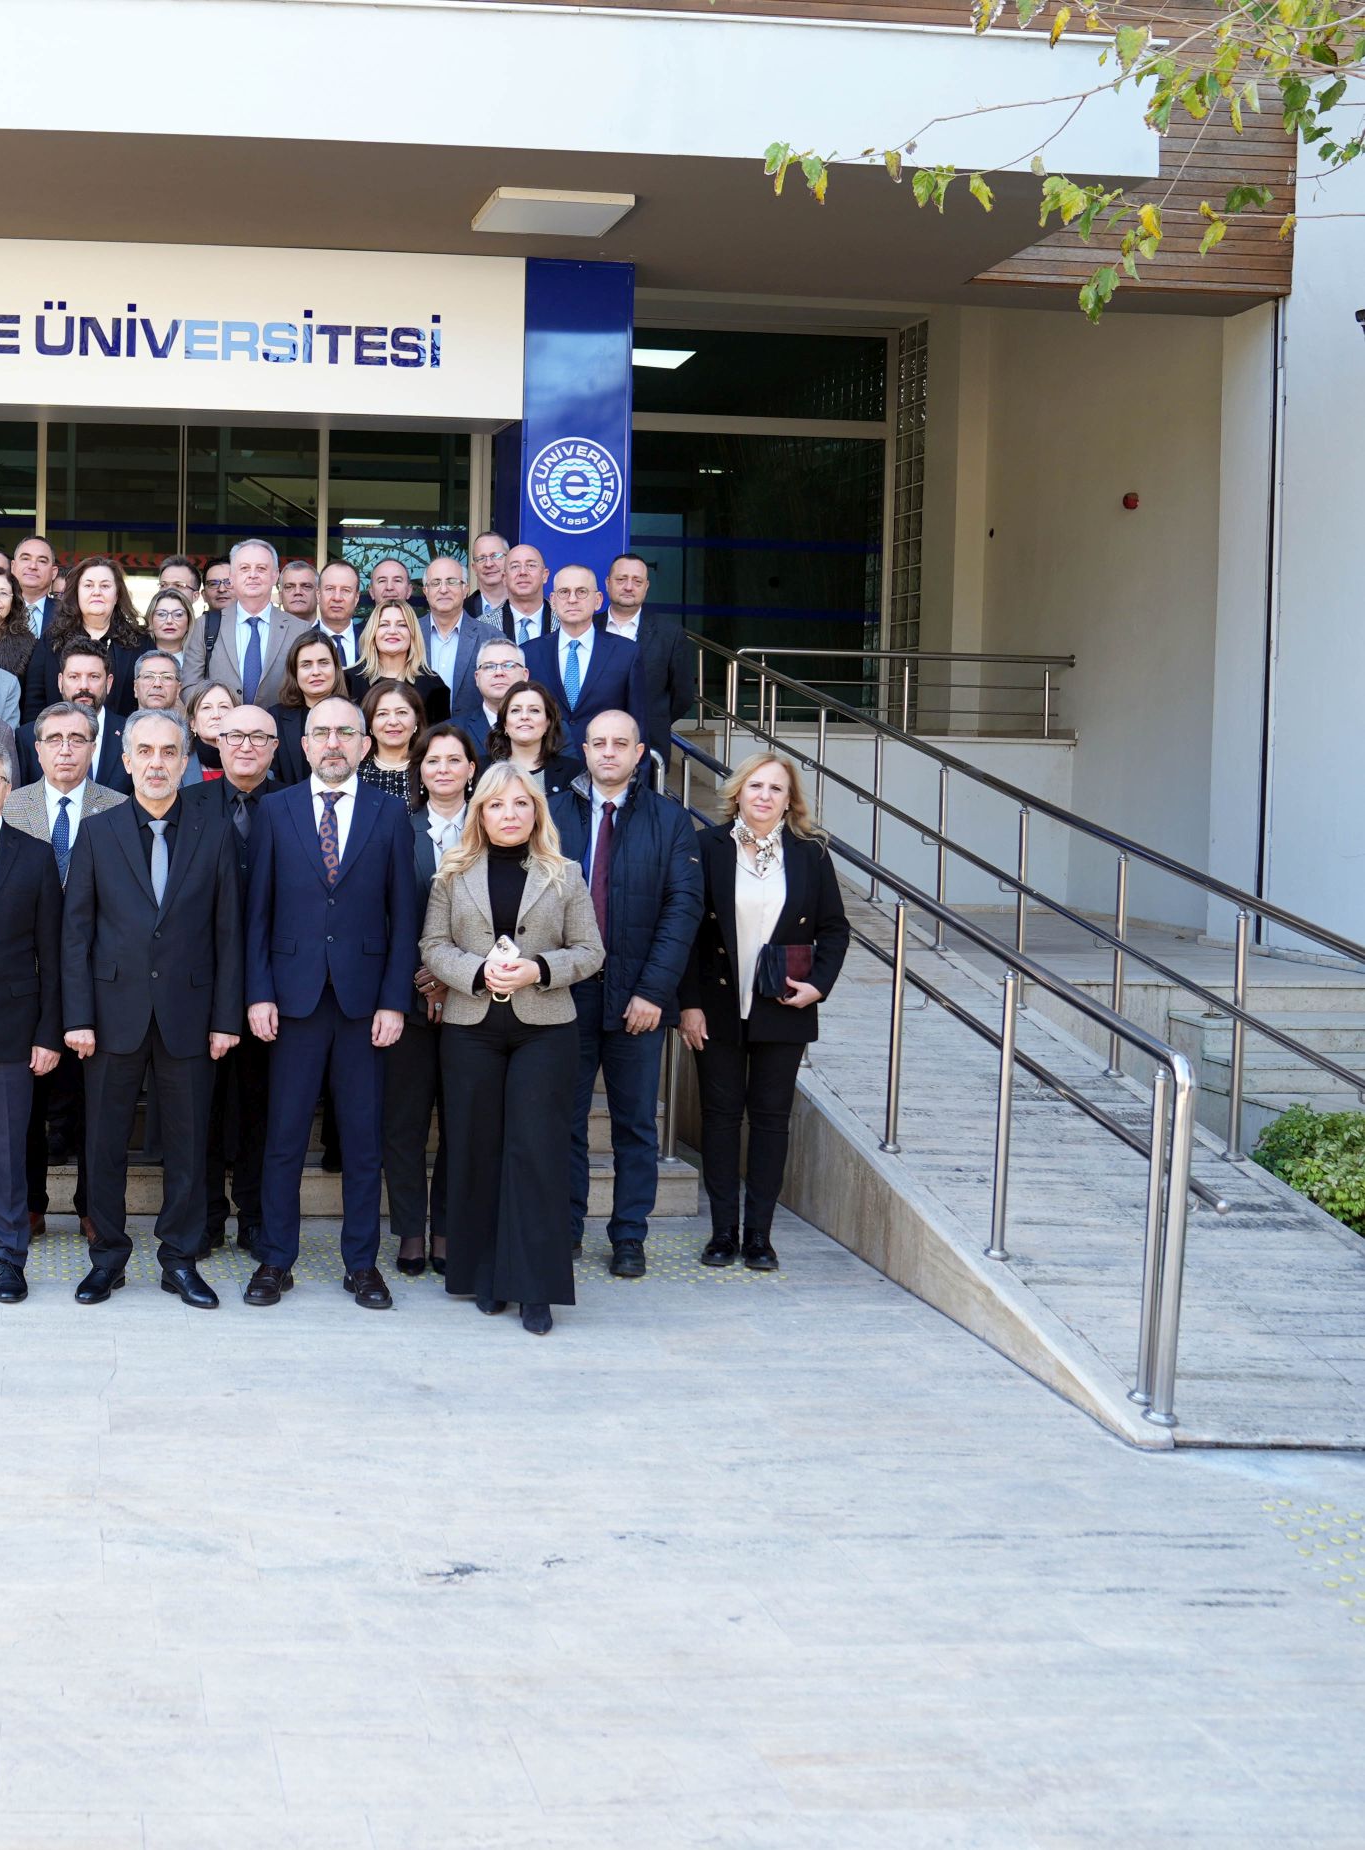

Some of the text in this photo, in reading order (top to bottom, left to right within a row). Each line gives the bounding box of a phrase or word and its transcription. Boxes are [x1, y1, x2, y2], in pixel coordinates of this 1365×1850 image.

[35, 300, 441, 369] ÜNİVERSİTESİ
[534, 444, 615, 521] EGE ÜNİVERSİTESİ
[561, 516, 589, 525] 1955
